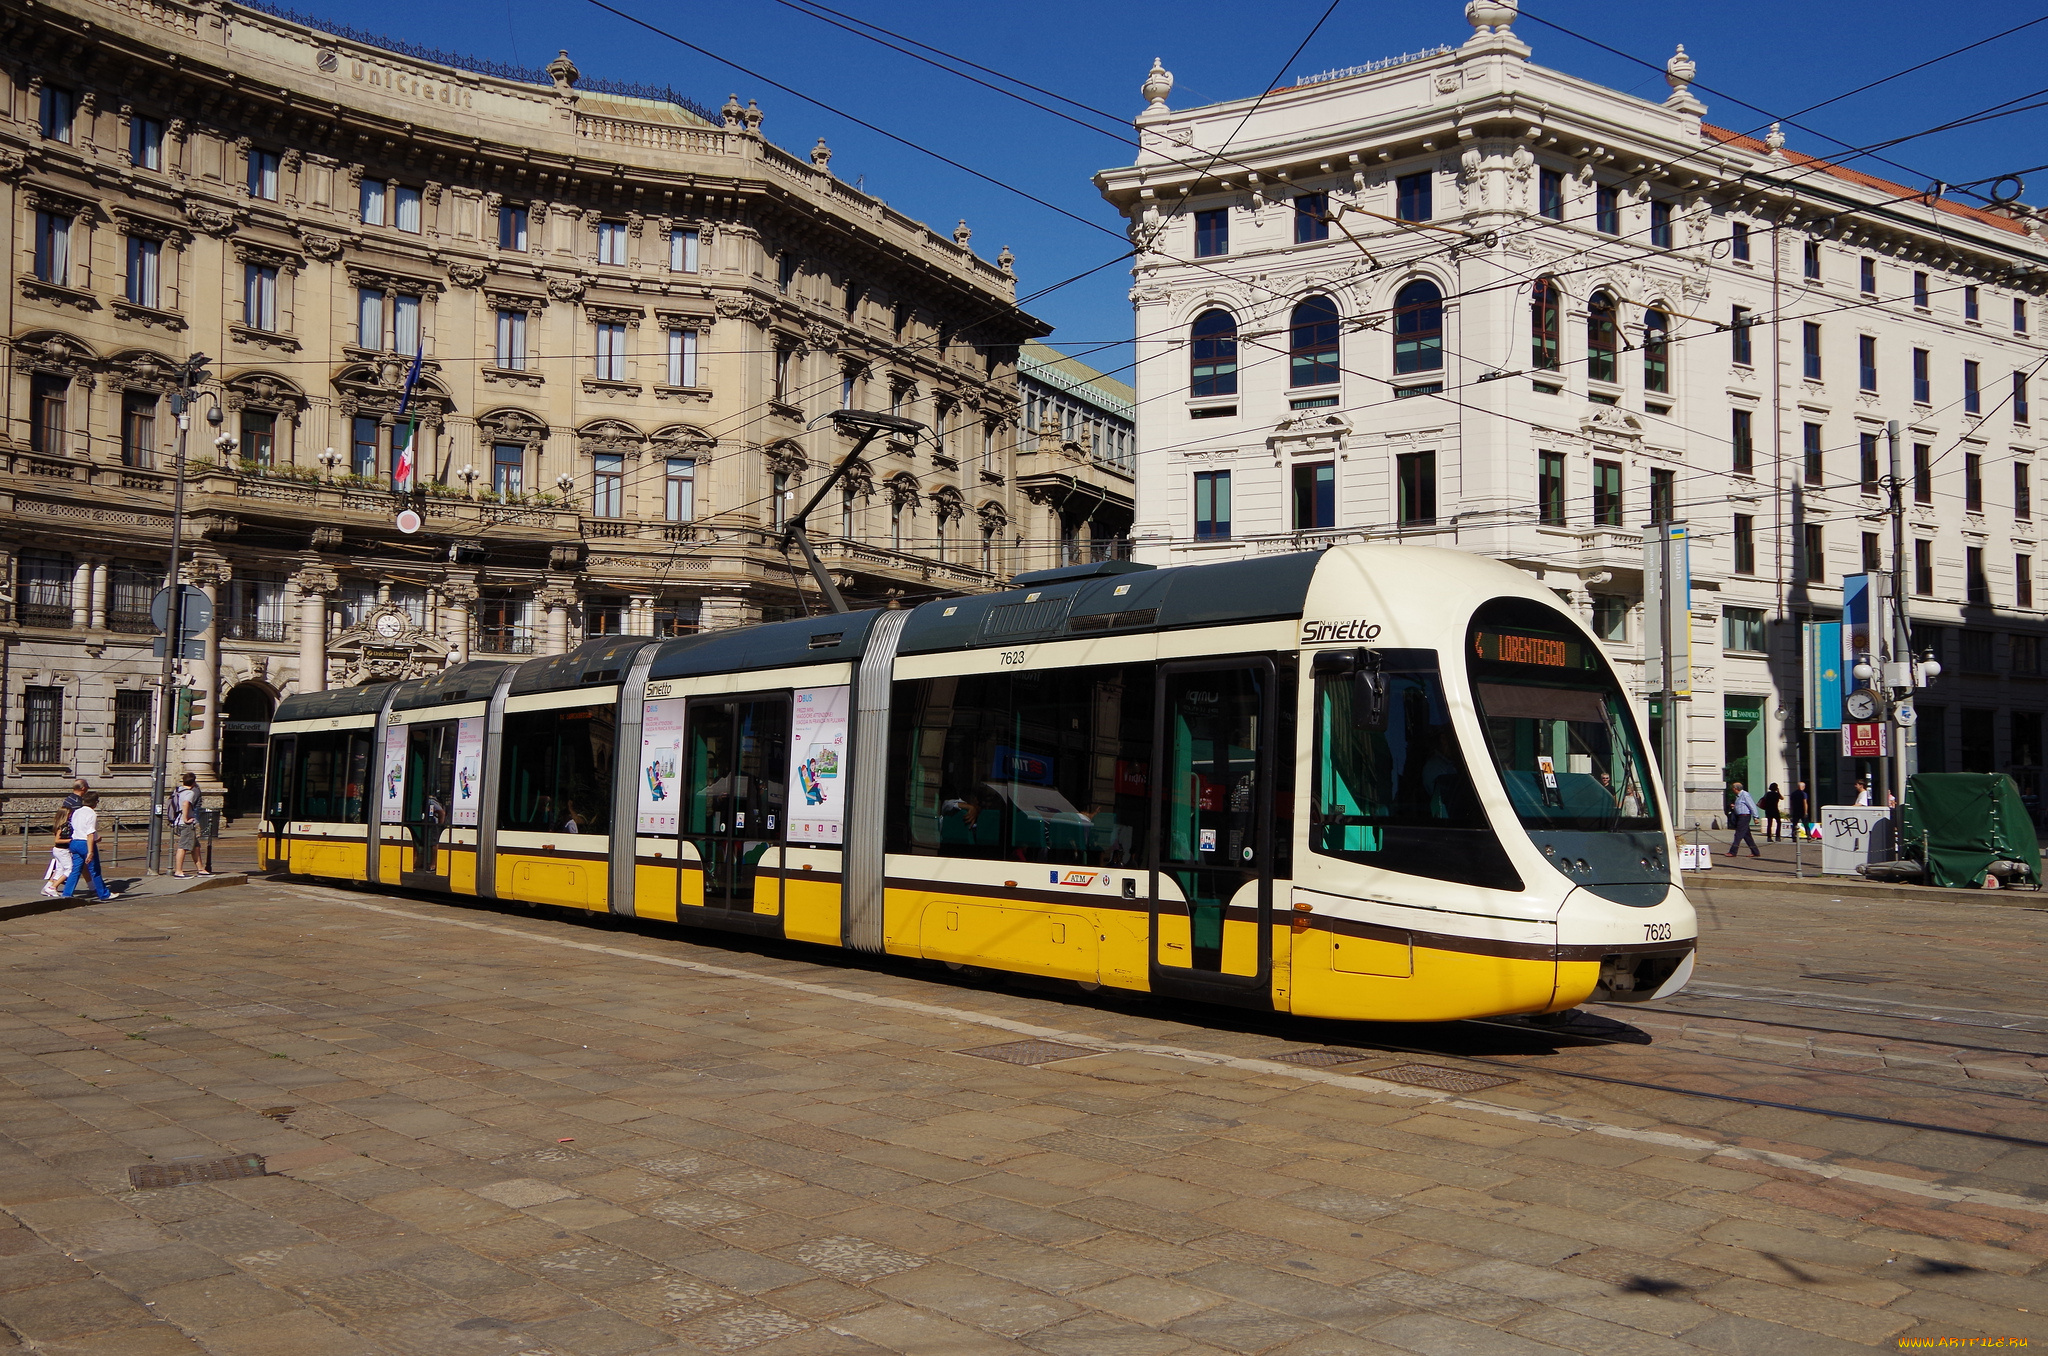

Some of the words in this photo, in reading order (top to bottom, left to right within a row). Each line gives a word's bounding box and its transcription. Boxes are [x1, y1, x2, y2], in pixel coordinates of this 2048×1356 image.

[1673, 544, 1682, 580] ucraina
[1301, 619, 1382, 642] Sirietto
[1000, 651, 1025, 666] 7623
[1499, 634, 1566, 667] LORENTEGGIO
[1853, 739, 1877, 747] ADER
[1684, 847, 1707, 857] EXO
[1070, 874, 1086, 883] ATM
[1643, 922, 1672, 941] 7623
